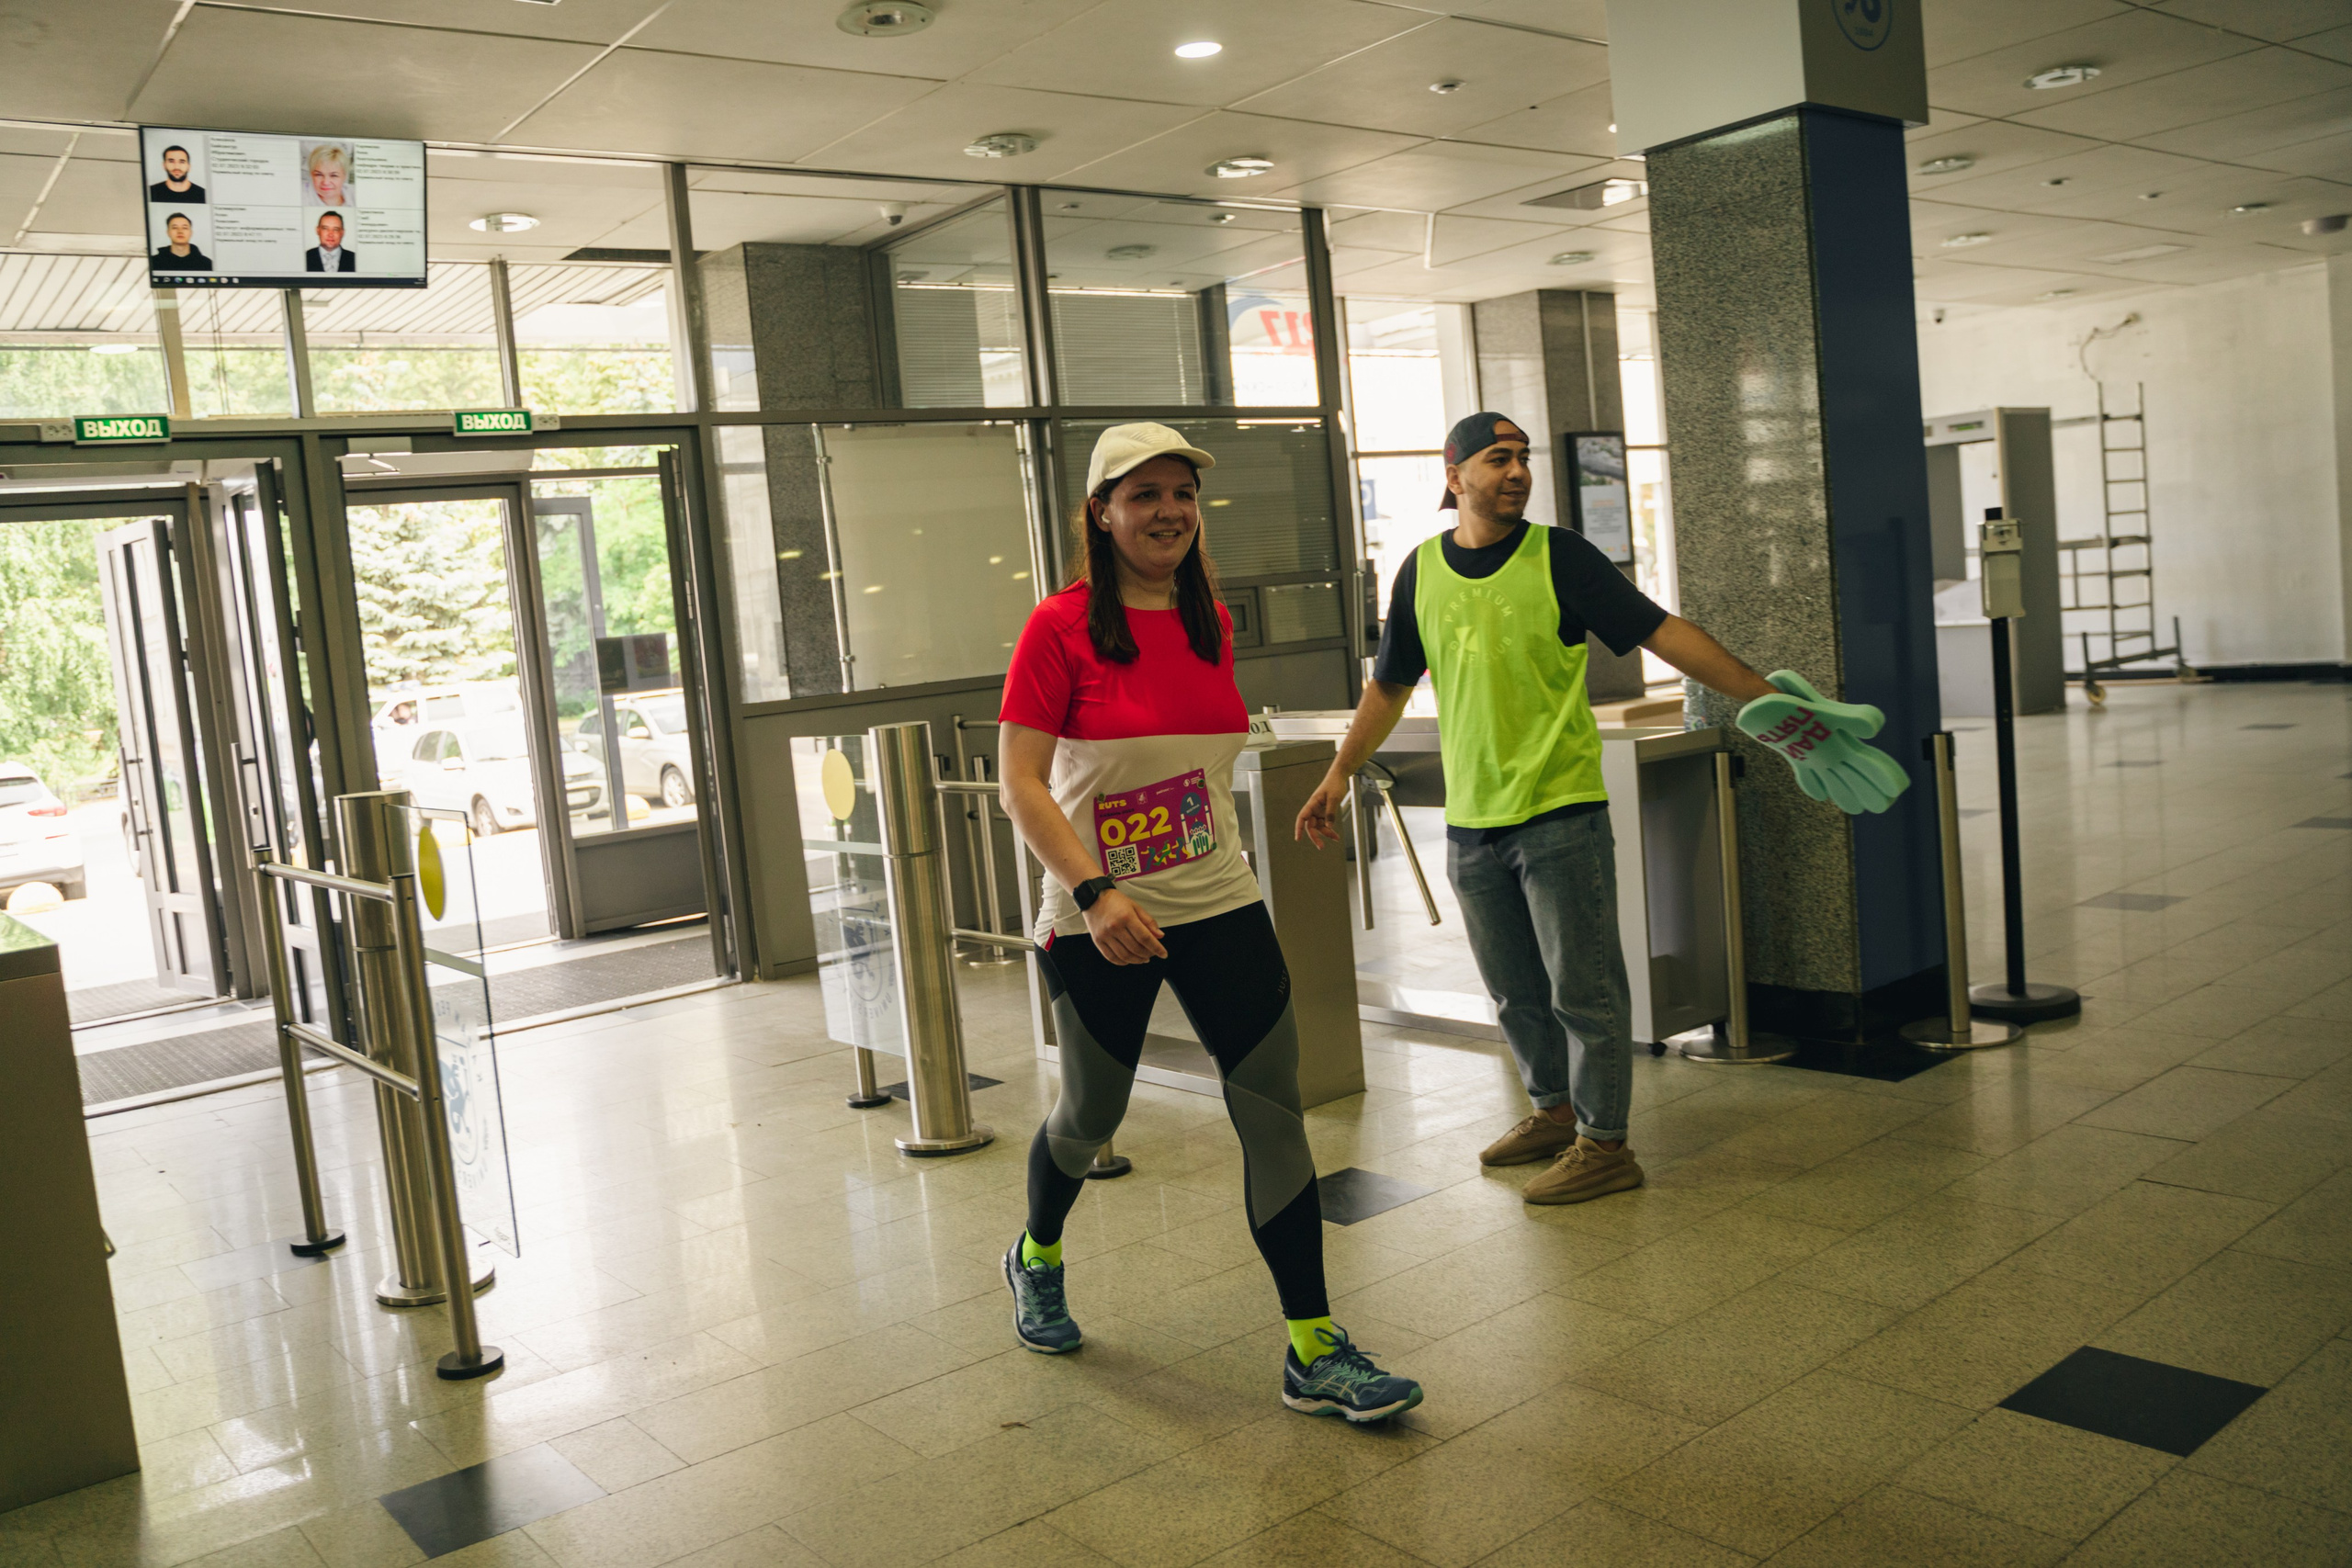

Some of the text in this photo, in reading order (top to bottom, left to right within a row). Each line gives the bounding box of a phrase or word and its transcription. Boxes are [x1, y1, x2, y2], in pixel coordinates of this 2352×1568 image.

[82, 419, 164, 439] ВЫХОД
[461, 411, 526, 432] ВЫХОД
[1444, 588, 1513, 623] PREMIUM
[1249, 720, 1272, 735] ОД
[1757, 705, 1816, 744] ПЯТЬ
[1780, 720, 1833, 761] ДАЙ
[1100, 806, 1173, 847] 022
